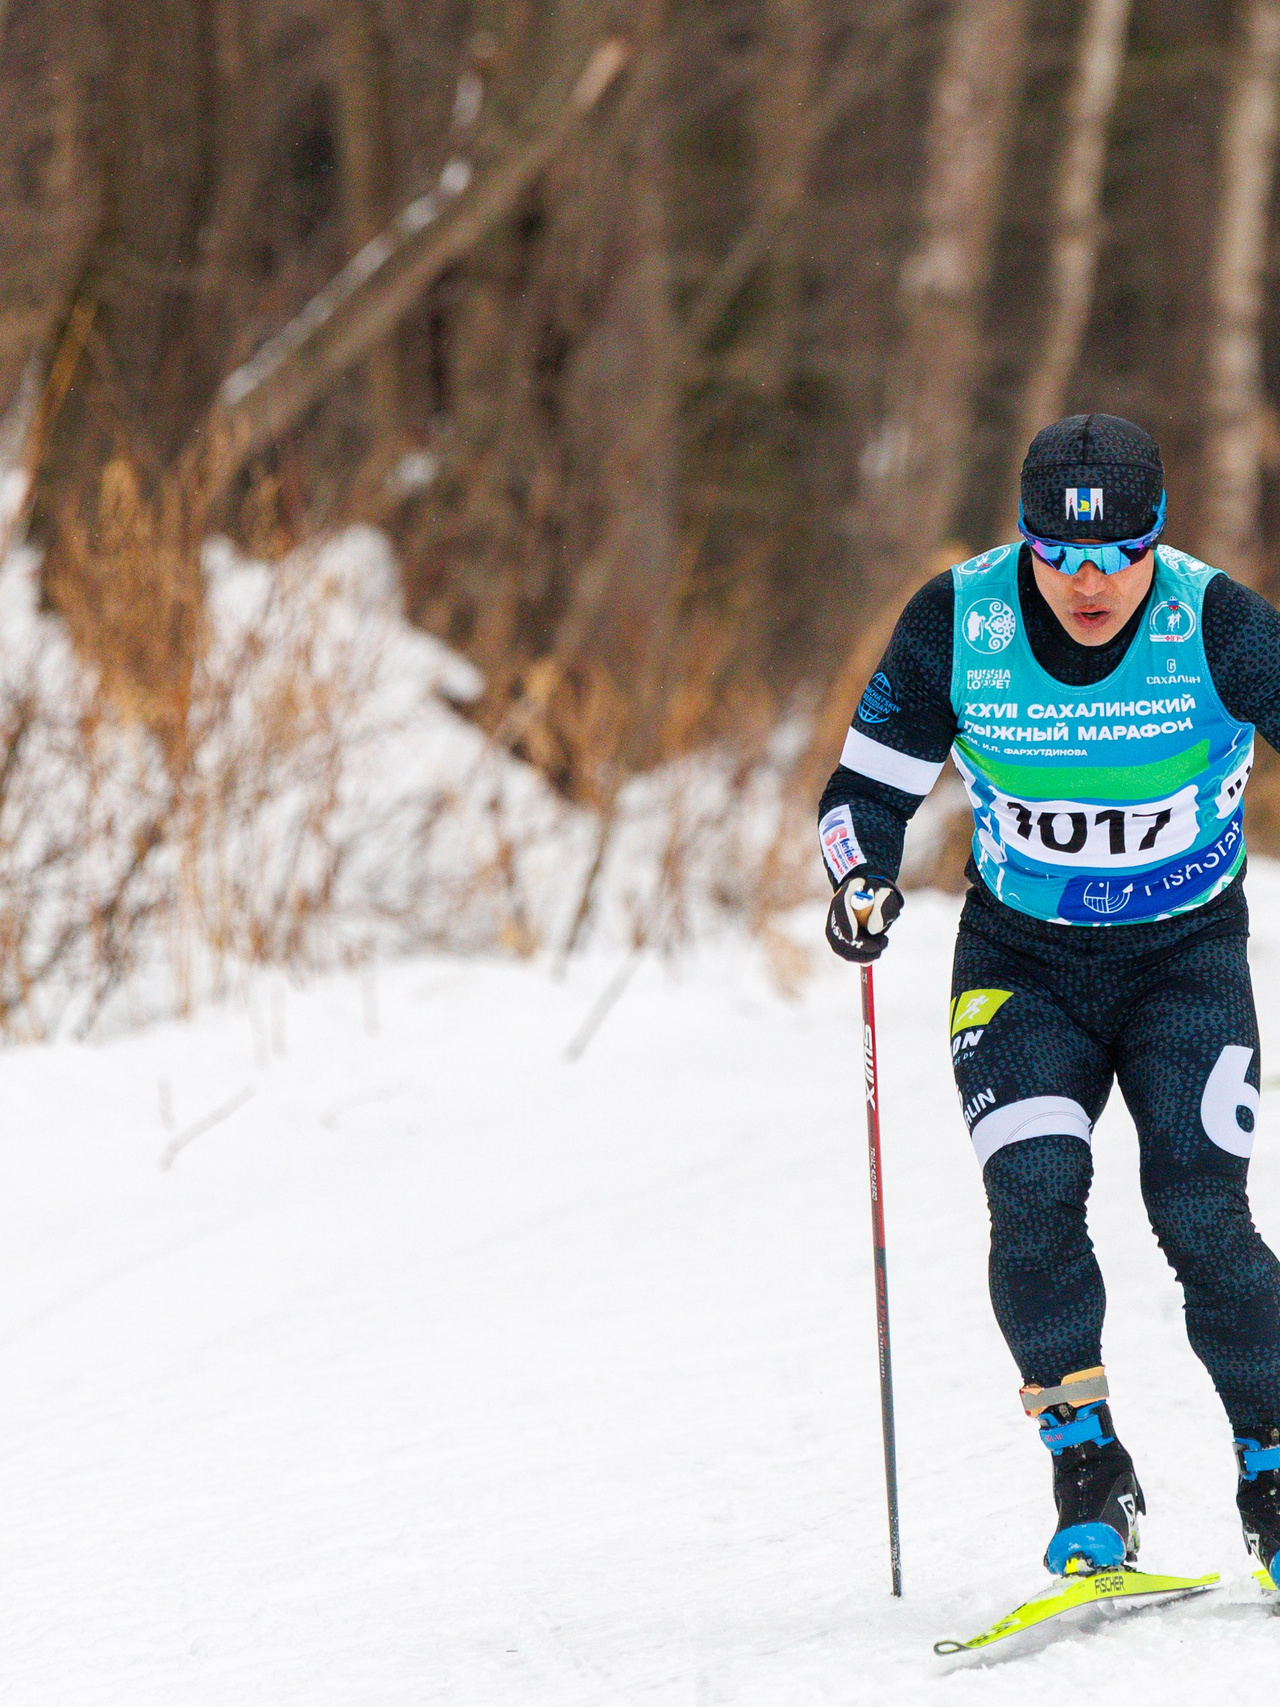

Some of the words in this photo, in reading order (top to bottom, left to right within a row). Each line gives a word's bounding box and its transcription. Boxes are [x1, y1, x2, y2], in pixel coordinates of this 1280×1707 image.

[967, 669, 1011, 681] RUSSIA
[1146, 675, 1201, 685] САХАЛИН
[1027, 693, 1196, 719] САХАЛИНСКИЙ
[963, 720, 1069, 742] ЛЫЖНЫЙ
[1077, 717, 1194, 741] МАРАФОН
[1003, 747, 1088, 757] ФАРХУТДИНОВА
[1006, 801, 1174, 855] 1017
[863, 1022, 876, 1111] SWIX
[1094, 1576, 1126, 1595] FISCHER
